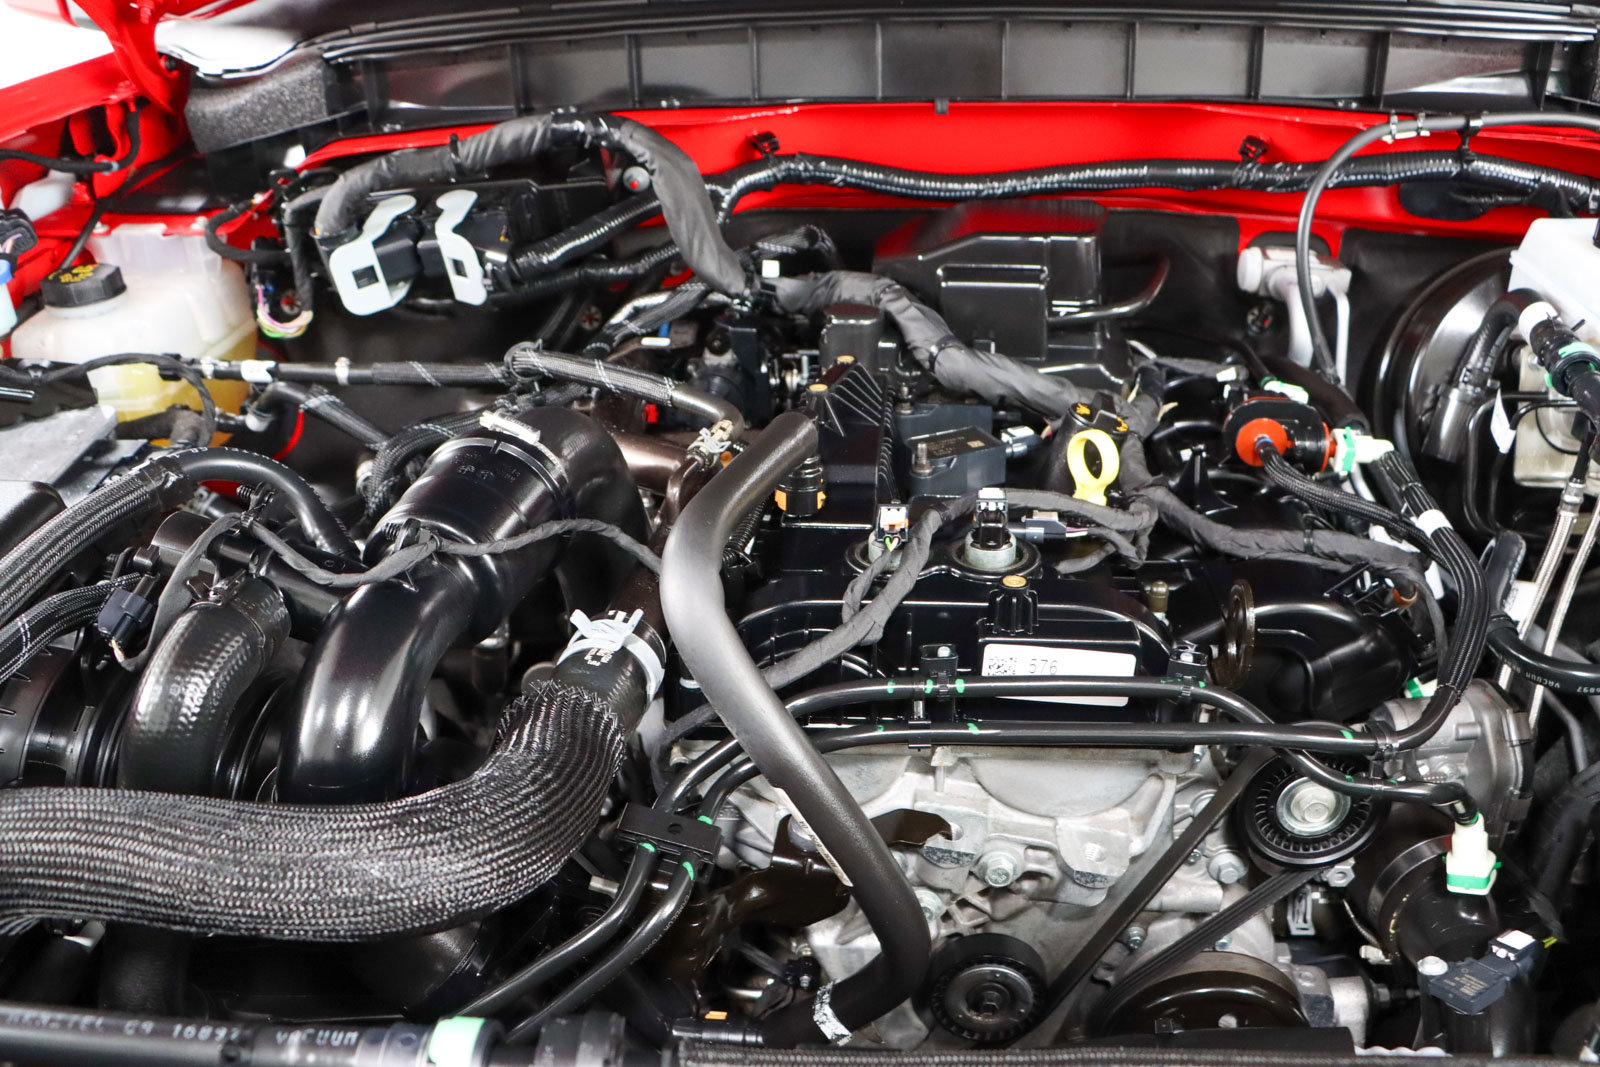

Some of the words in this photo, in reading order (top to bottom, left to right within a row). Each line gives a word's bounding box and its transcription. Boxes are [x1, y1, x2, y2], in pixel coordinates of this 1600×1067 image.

[1028, 658, 1058, 675] 576
[1525, 671, 1560, 688] VACUUM
[275, 1028, 360, 1047] VACUUM
